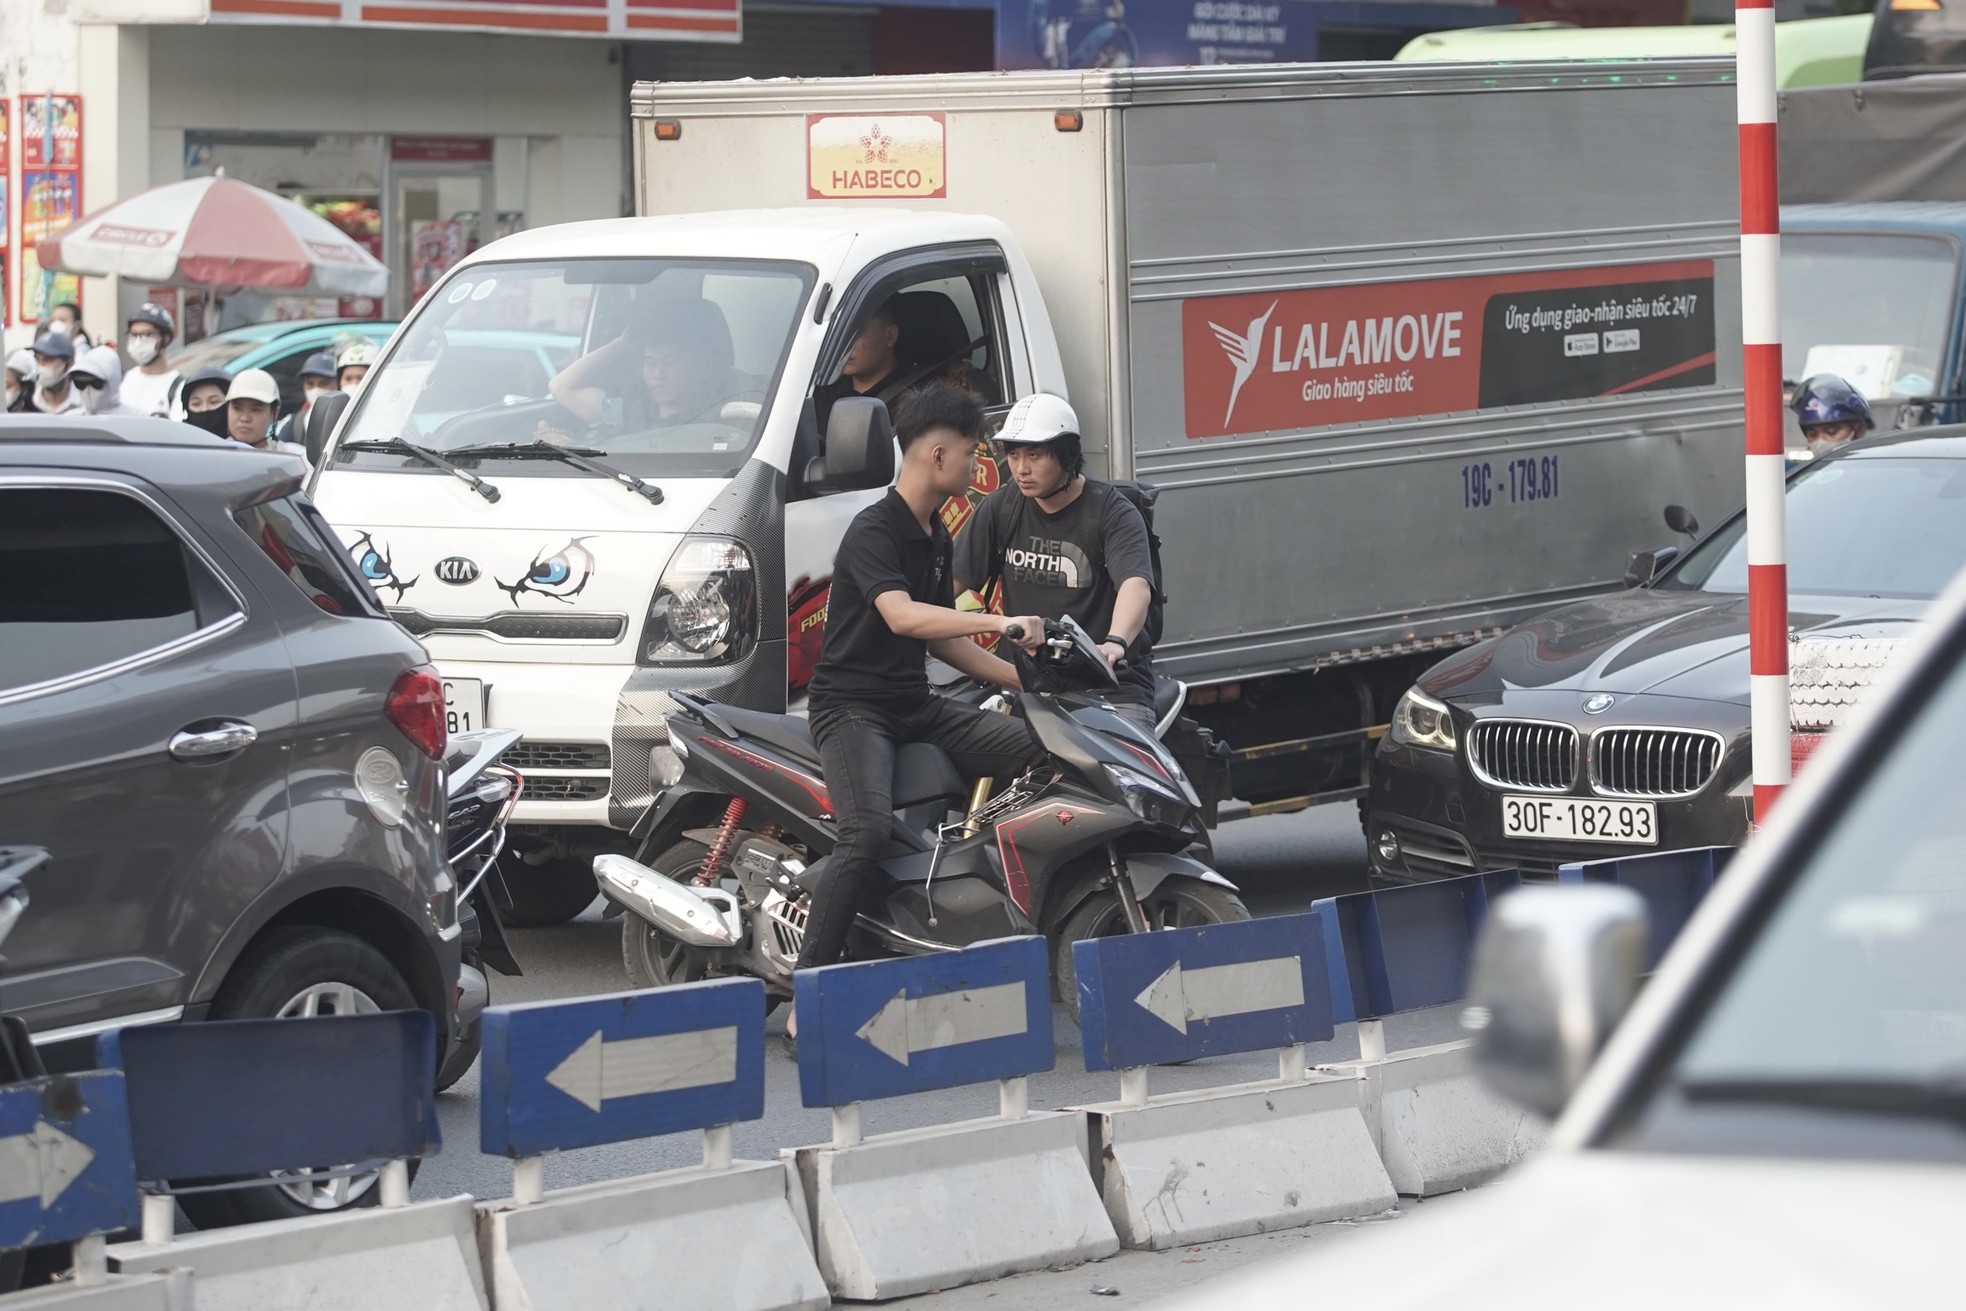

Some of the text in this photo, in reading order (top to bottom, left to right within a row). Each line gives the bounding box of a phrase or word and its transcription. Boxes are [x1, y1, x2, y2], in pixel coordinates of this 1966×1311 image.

[832, 169, 921, 189] HABECO
[1505, 293, 1698, 334] Ứng dụng giao-nhận siêu tốc 24/7
[1272, 311, 1463, 372] LALAMOVE
[1302, 368, 1414, 402] Giao hàng siêu tốc
[1462, 462, 1492, 508] 19C
[1508, 455, 1558, 503] 179.81
[1005, 547, 1060, 572] NORTH
[1029, 535, 1060, 555] THE
[440, 561, 473, 579] KIA
[1014, 567, 1059, 586] FACE
[1507, 800, 1651, 838] 30F-182.93
